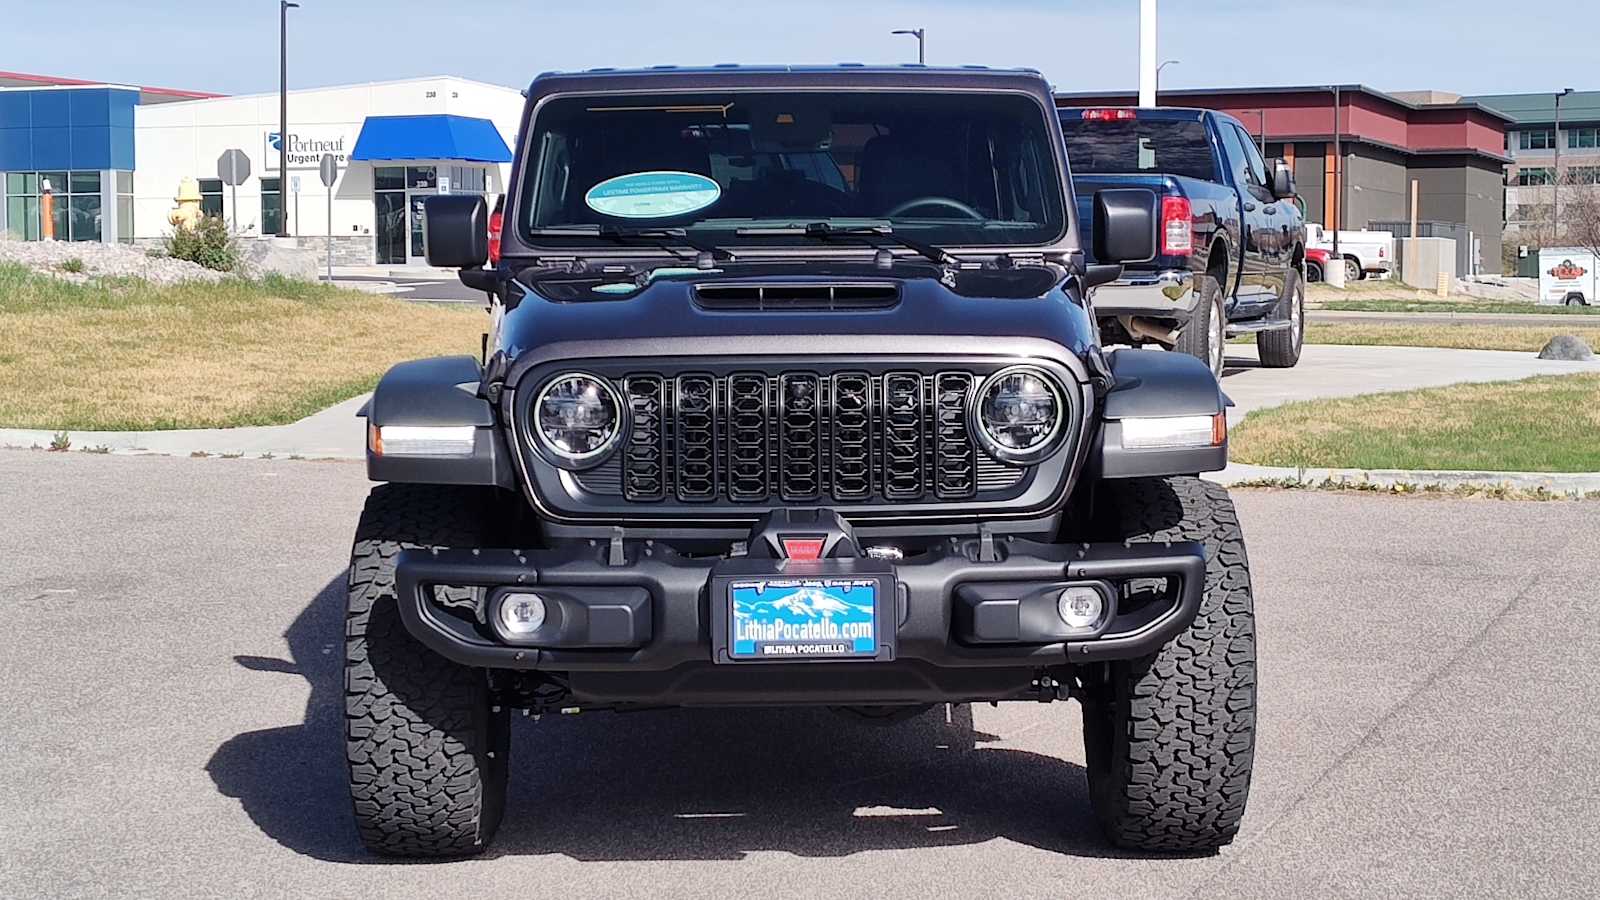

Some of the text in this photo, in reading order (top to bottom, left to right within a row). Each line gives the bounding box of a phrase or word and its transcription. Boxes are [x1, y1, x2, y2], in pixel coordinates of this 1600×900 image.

[287, 134, 344, 152] Portneuf
[287, 154, 320, 164] Urgent
[736, 618, 872, 640] LithiaPocatello.com
[797, 644, 845, 654] POCATELLO
